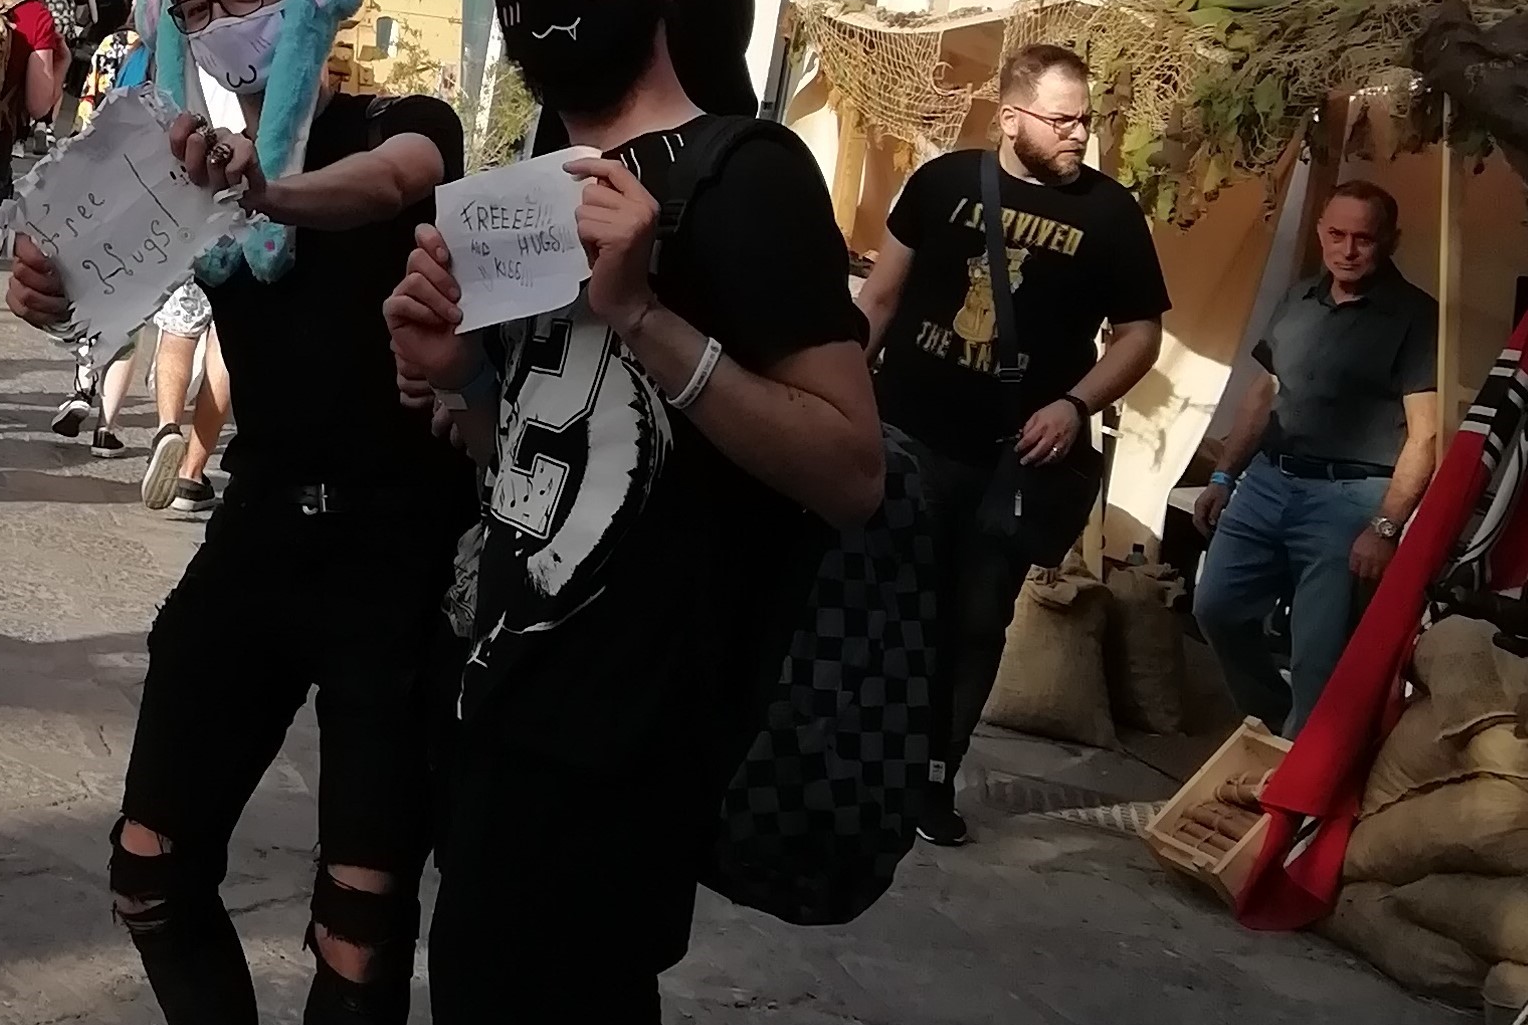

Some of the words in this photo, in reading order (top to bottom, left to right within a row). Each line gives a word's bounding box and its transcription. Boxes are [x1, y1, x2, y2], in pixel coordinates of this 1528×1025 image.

[949, 198, 969, 223] I
[964, 202, 1085, 257] SRVIVED
[916, 320, 953, 360] THE
